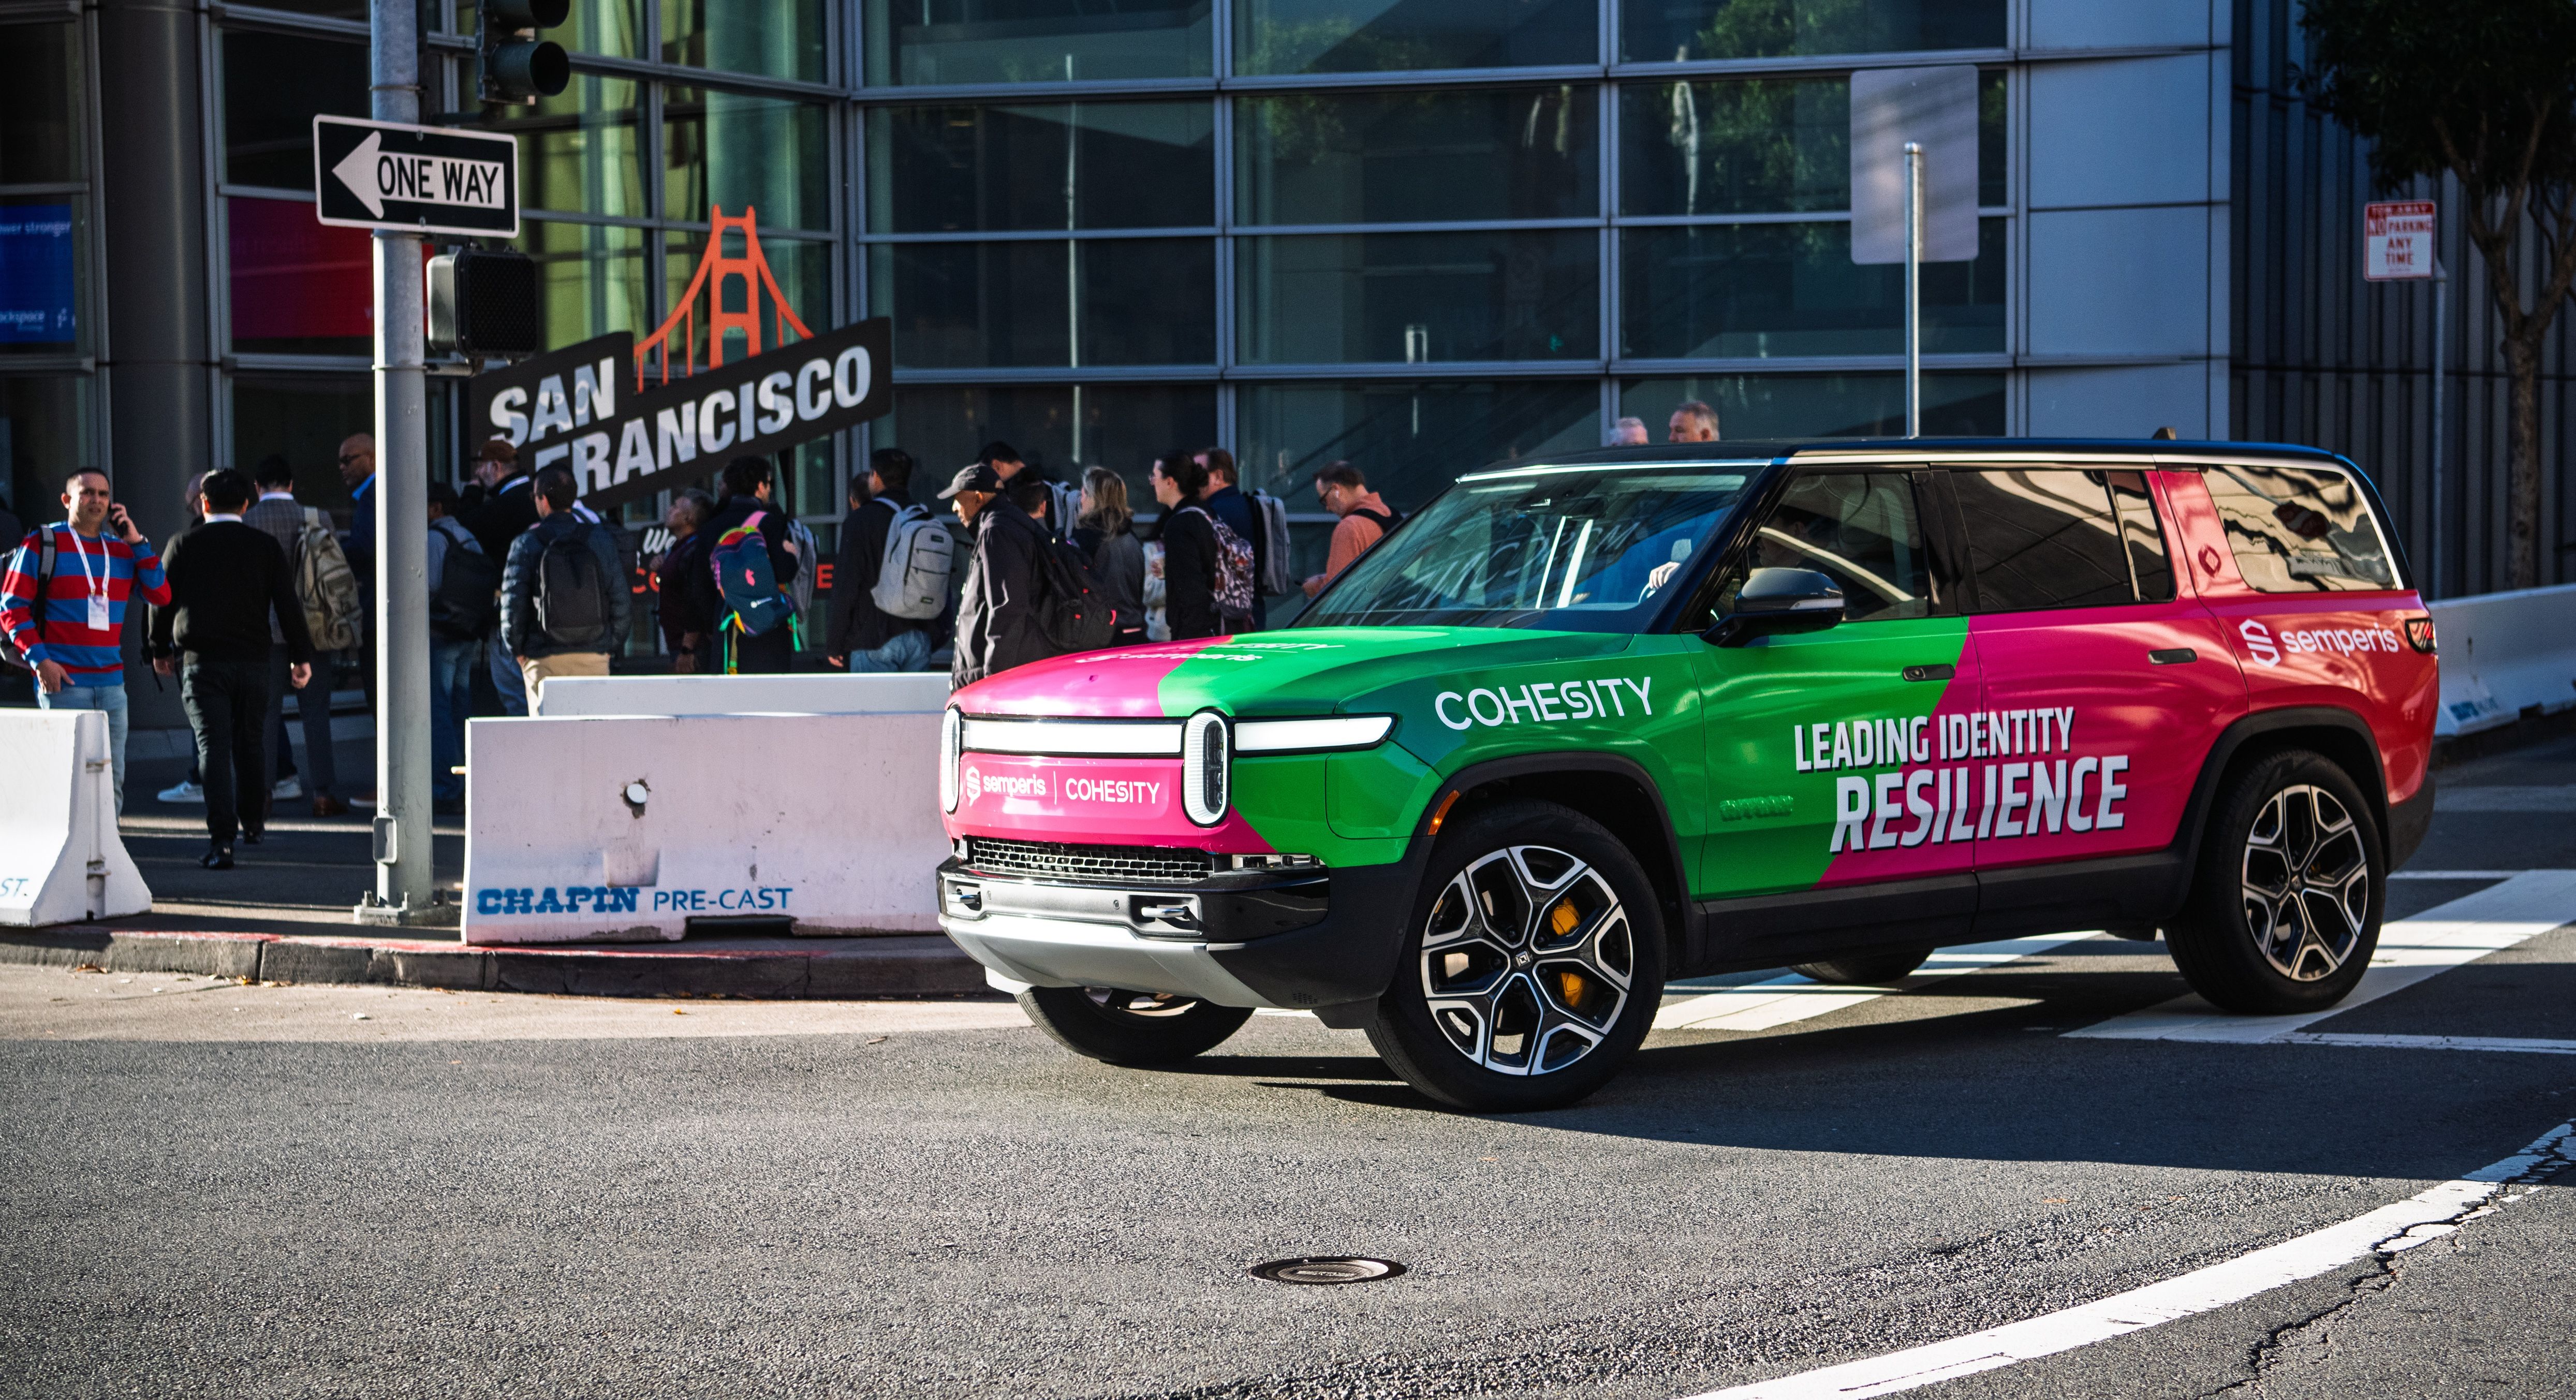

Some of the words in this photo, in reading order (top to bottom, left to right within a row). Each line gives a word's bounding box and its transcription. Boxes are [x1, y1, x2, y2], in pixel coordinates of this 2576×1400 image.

[377, 155, 434, 199] ONE
[442, 161, 499, 204] WAY
[2369, 219, 2386, 234] NO
[2389, 220, 2432, 233] PARKING
[2388, 238, 2411, 249] ANY
[2386, 252, 2413, 266] TIME
[489, 356, 615, 449] SAN
[2280, 622, 2399, 658] semperis
[1435, 676, 1652, 730] COHESITY
[1794, 715, 1931, 773] LEADING
[1938, 706, 2075, 762] IDENTITY
[983, 774, 1046, 798] semperis
[1065, 778, 1160, 804] COHESITY
[1829, 755, 2129, 854] RESILIENCE
[477, 887, 640, 915] CHAPIN
[654, 888, 793, 911] PRE-CAST
